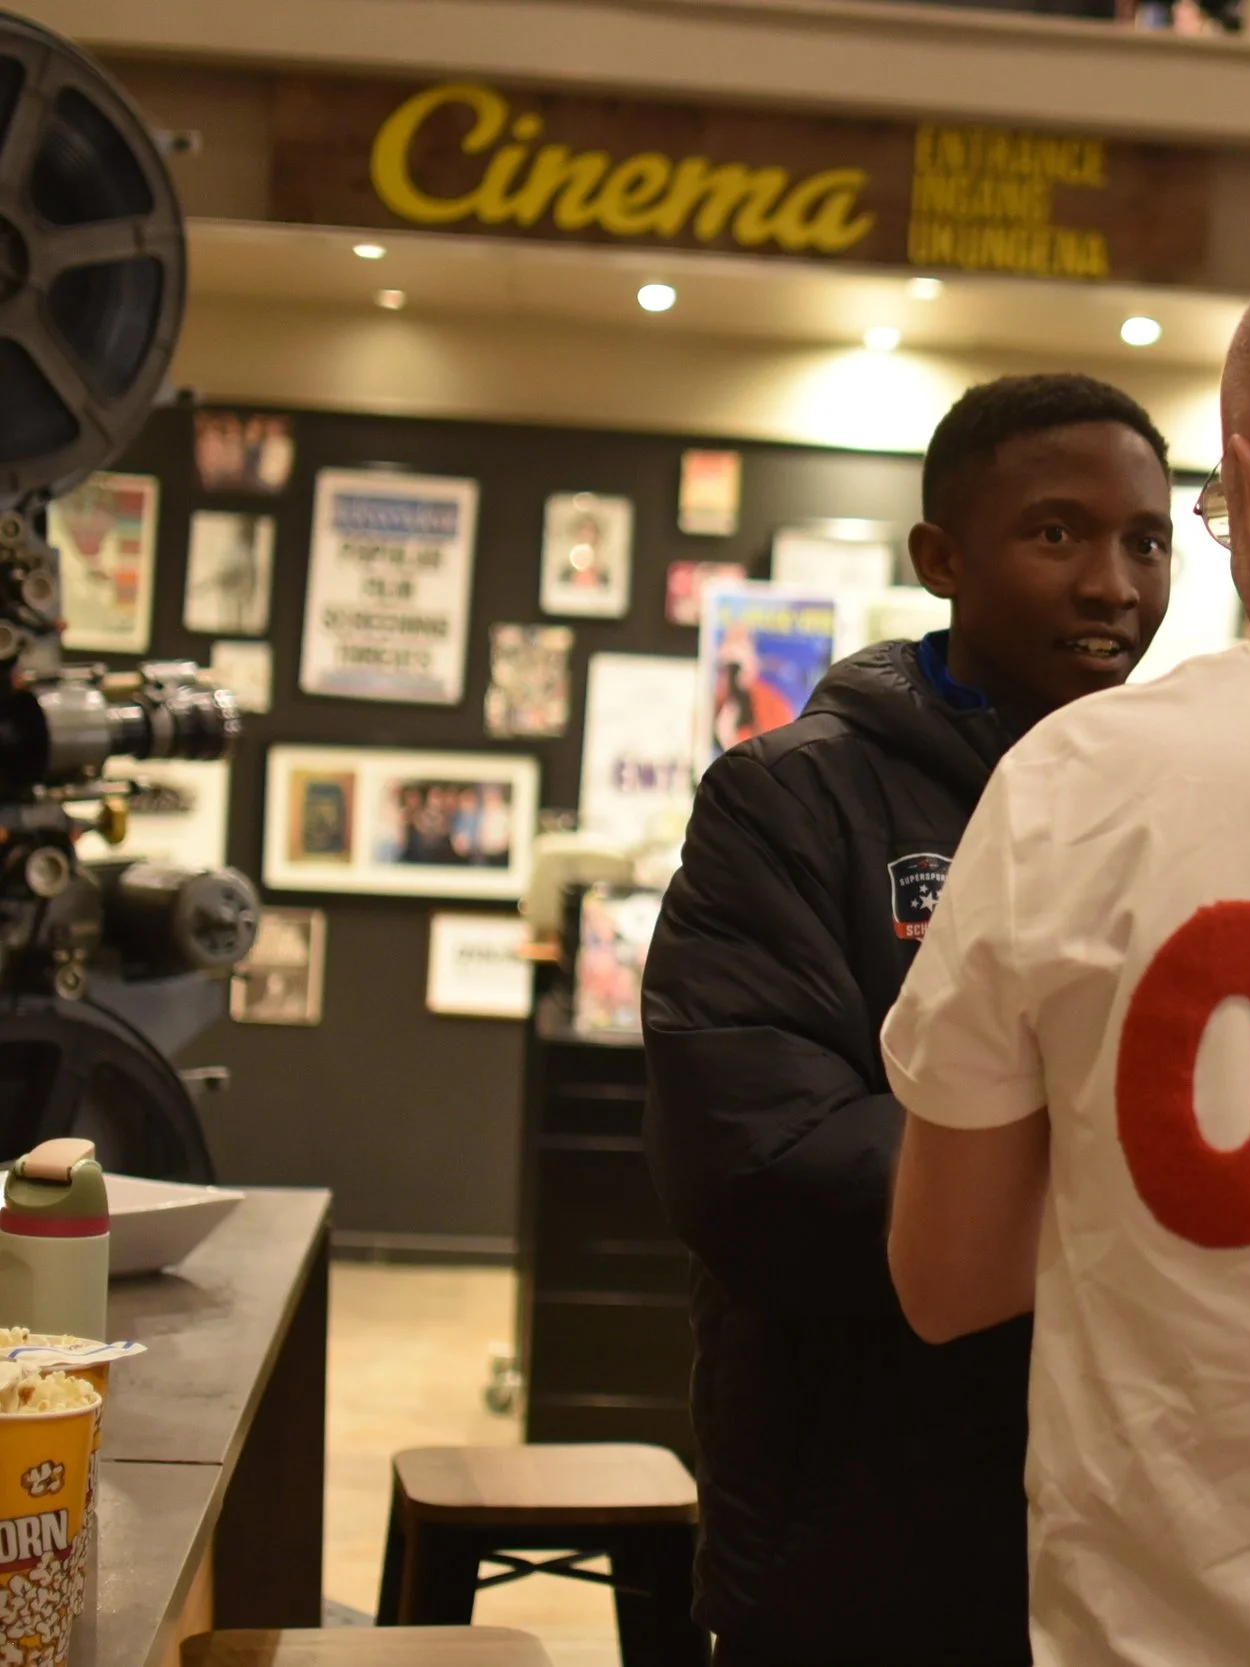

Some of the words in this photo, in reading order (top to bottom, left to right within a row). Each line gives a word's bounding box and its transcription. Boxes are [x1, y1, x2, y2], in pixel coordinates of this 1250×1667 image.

[369, 82, 876, 254] Cinema
[914, 126, 1106, 187] ENTRANCE
[900, 873, 946, 886] SUPERSPOR
[906, 924, 928, 936] SCH
